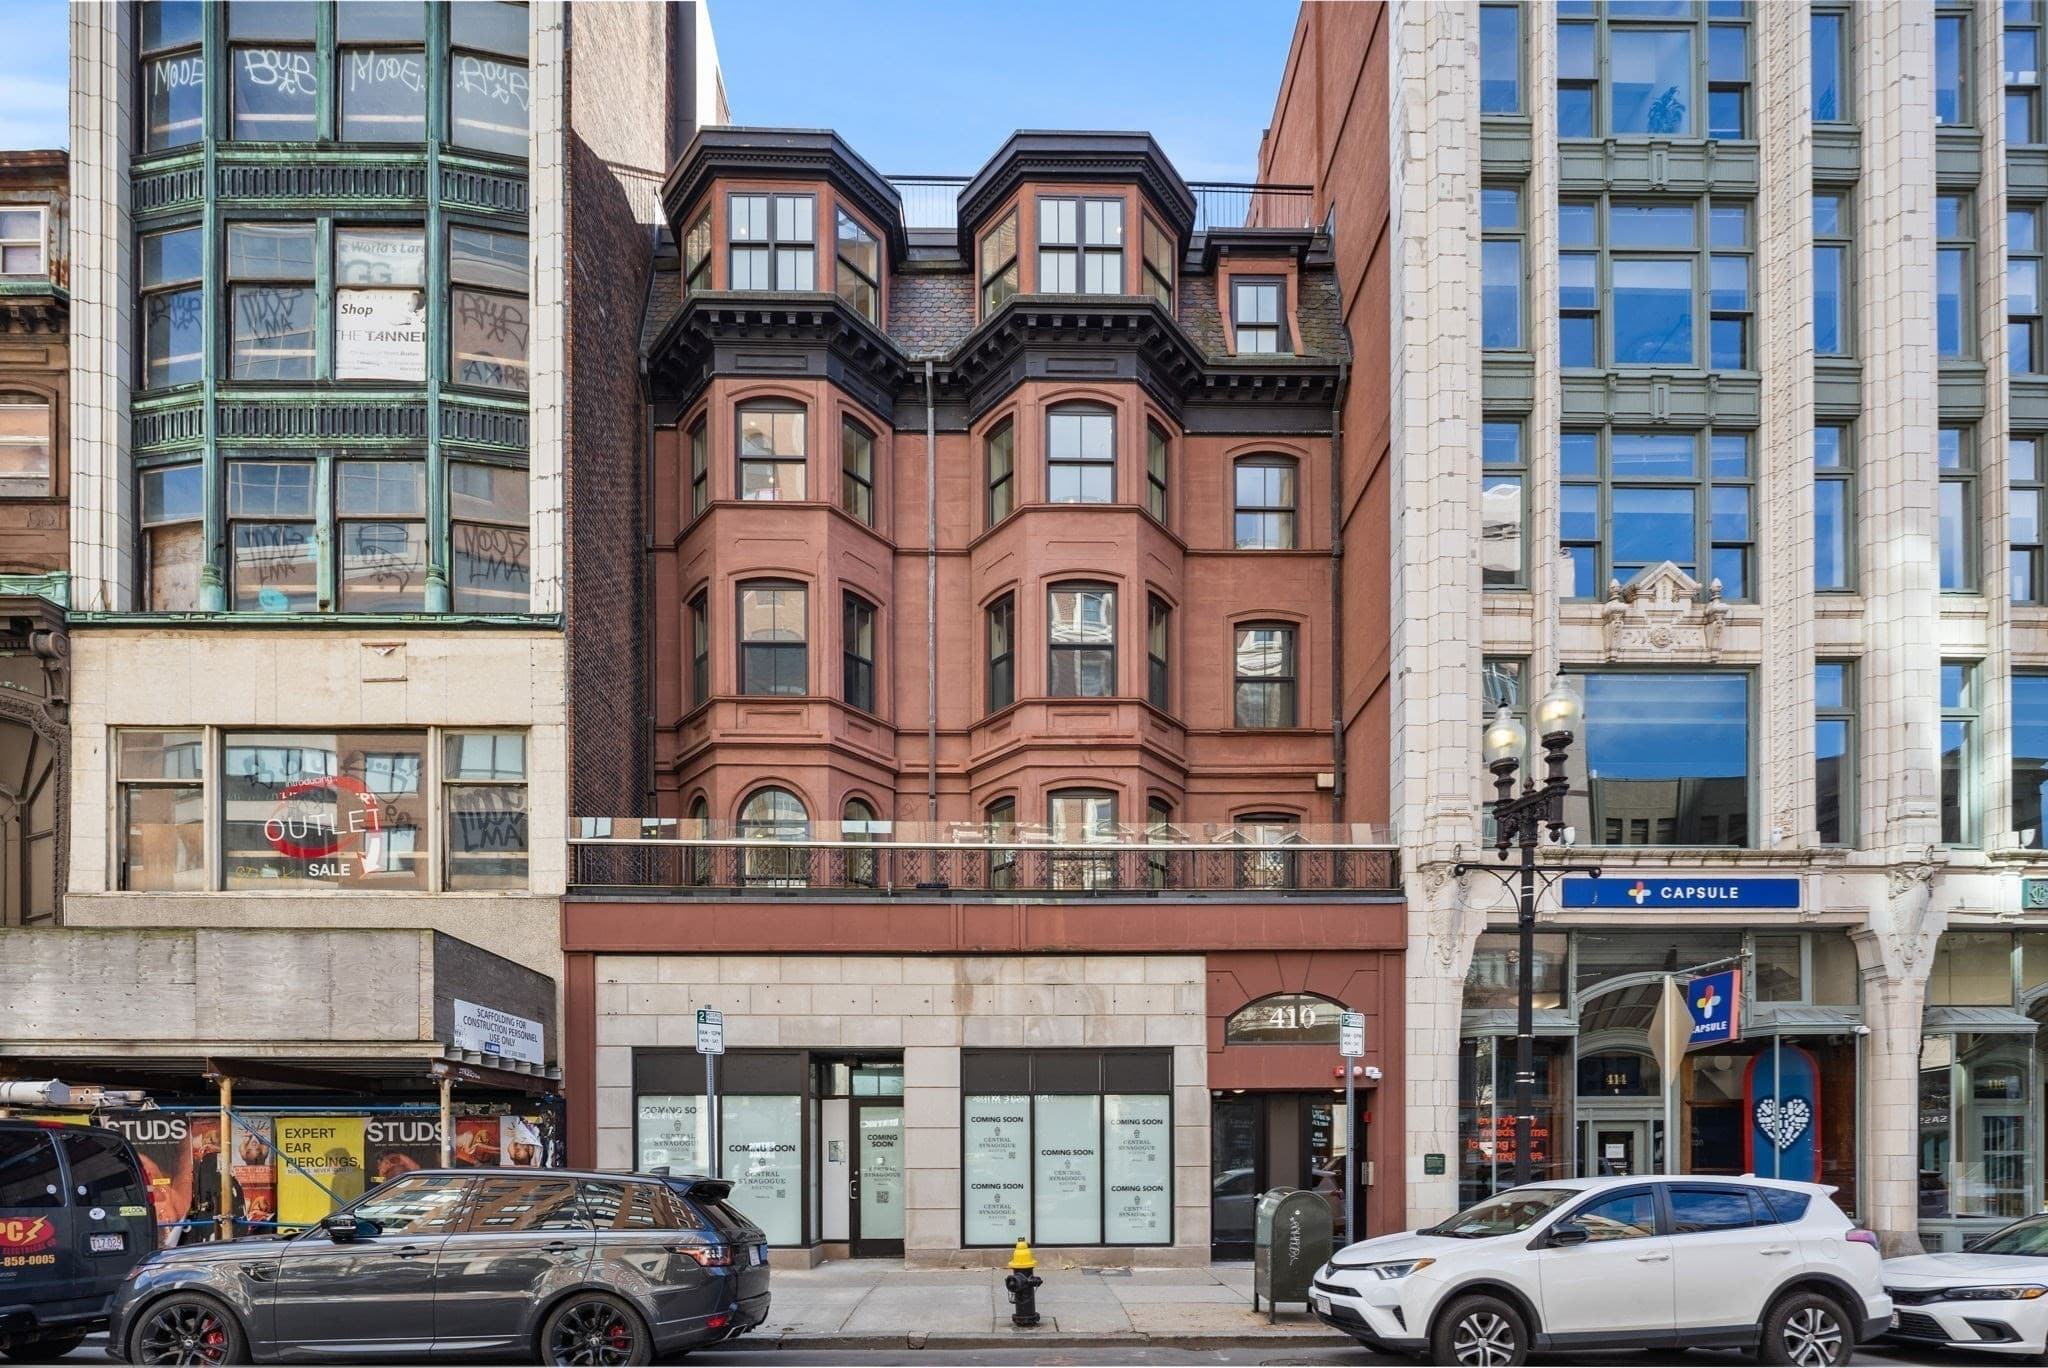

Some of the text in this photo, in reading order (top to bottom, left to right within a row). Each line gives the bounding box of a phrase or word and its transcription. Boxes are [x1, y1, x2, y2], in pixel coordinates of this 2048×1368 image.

[341, 304, 373, 318] Shop
[264, 808, 379, 842] OUTLET
[308, 863, 350, 877] SALE
[1660, 886, 1739, 899] CAPSULE
[477, 1008, 526, 1030] SCAFFOLDING FOR
[1269, 1007, 1316, 1029] 410
[463, 1016, 507, 1035] CONSTRUCTION
[508, 1028, 538, 1043] PERSONNEL
[1692, 1020, 1728, 1034] APSULE
[489, 1033, 516, 1047] USE ONLY
[644, 1106, 683, 1114] COMING
[285, 1128, 336, 1139] EXPERT
[285, 1142, 312, 1153] EAR
[769, 1144, 796, 1152] SOON
